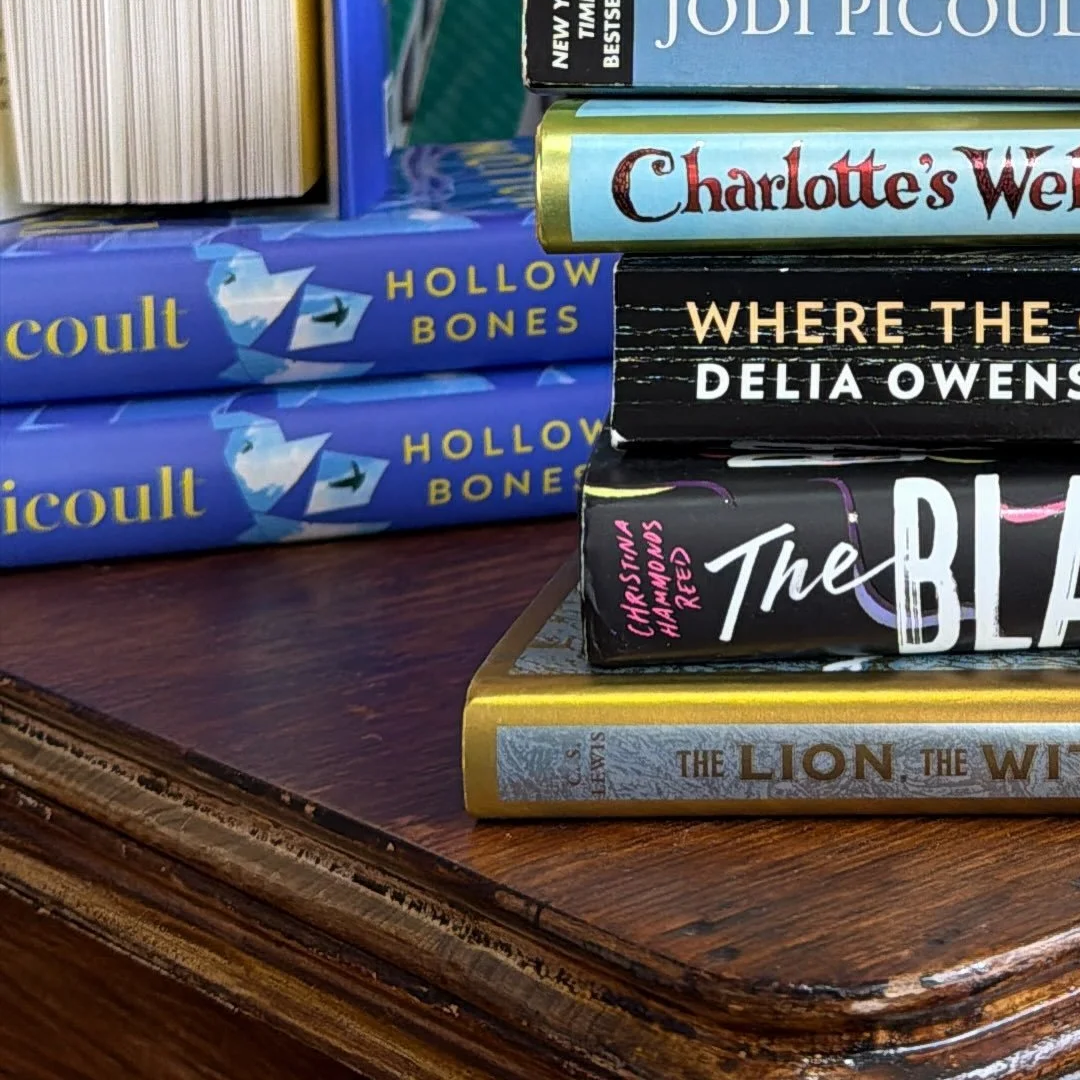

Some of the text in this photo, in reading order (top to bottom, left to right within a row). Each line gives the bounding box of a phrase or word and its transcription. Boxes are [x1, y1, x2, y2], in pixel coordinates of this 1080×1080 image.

[552, 15, 570, 69] NEW
[611, 140, 958, 223] Charlotte's
[6, 259, 601, 361] coult HOLLOW
[411, 305, 580, 345] BONES
[686, 301, 905, 345] WHERE
[931, 301, 1051, 345] THE
[696, 363, 863, 400] DELIA
[2, 465, 206, 536] icoult
[614, 520, 655, 637] CHRISTINA
[642, 520, 681, 638] HAMMONDS
[670, 546, 702, 610] REED
[704, 523, 900, 642] The
[590, 731, 606, 797] LEWIS
[676, 749, 725, 778] THE
[920, 748, 967, 777] THE
